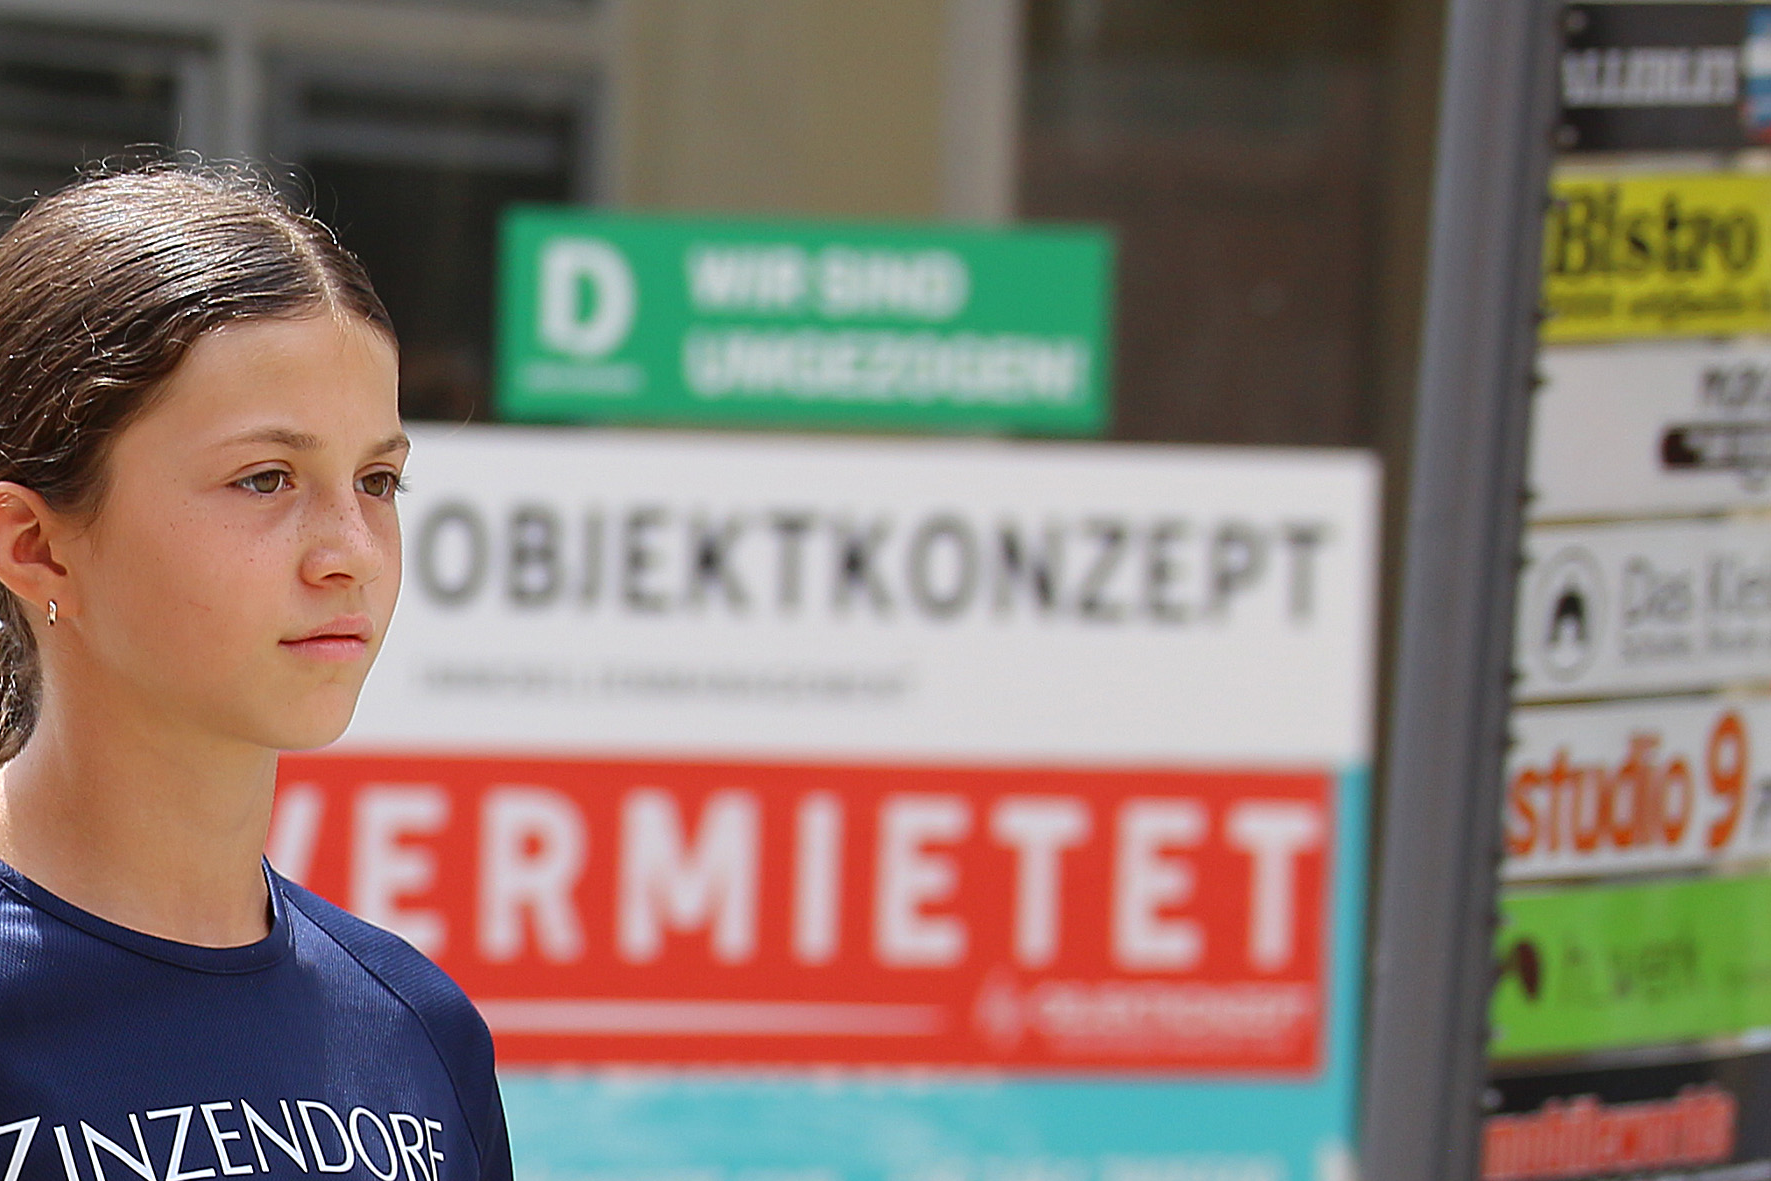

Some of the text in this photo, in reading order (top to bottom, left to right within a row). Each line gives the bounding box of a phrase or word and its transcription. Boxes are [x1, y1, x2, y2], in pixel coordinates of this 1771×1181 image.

[686, 243, 968, 320] WIR SIND
[1548, 184, 1758, 274] Bistro
[415, 500, 1333, 624] OBJEKTKONZEPT
[1506, 733, 1694, 858] studio
[1708, 708, 1748, 856] 9
